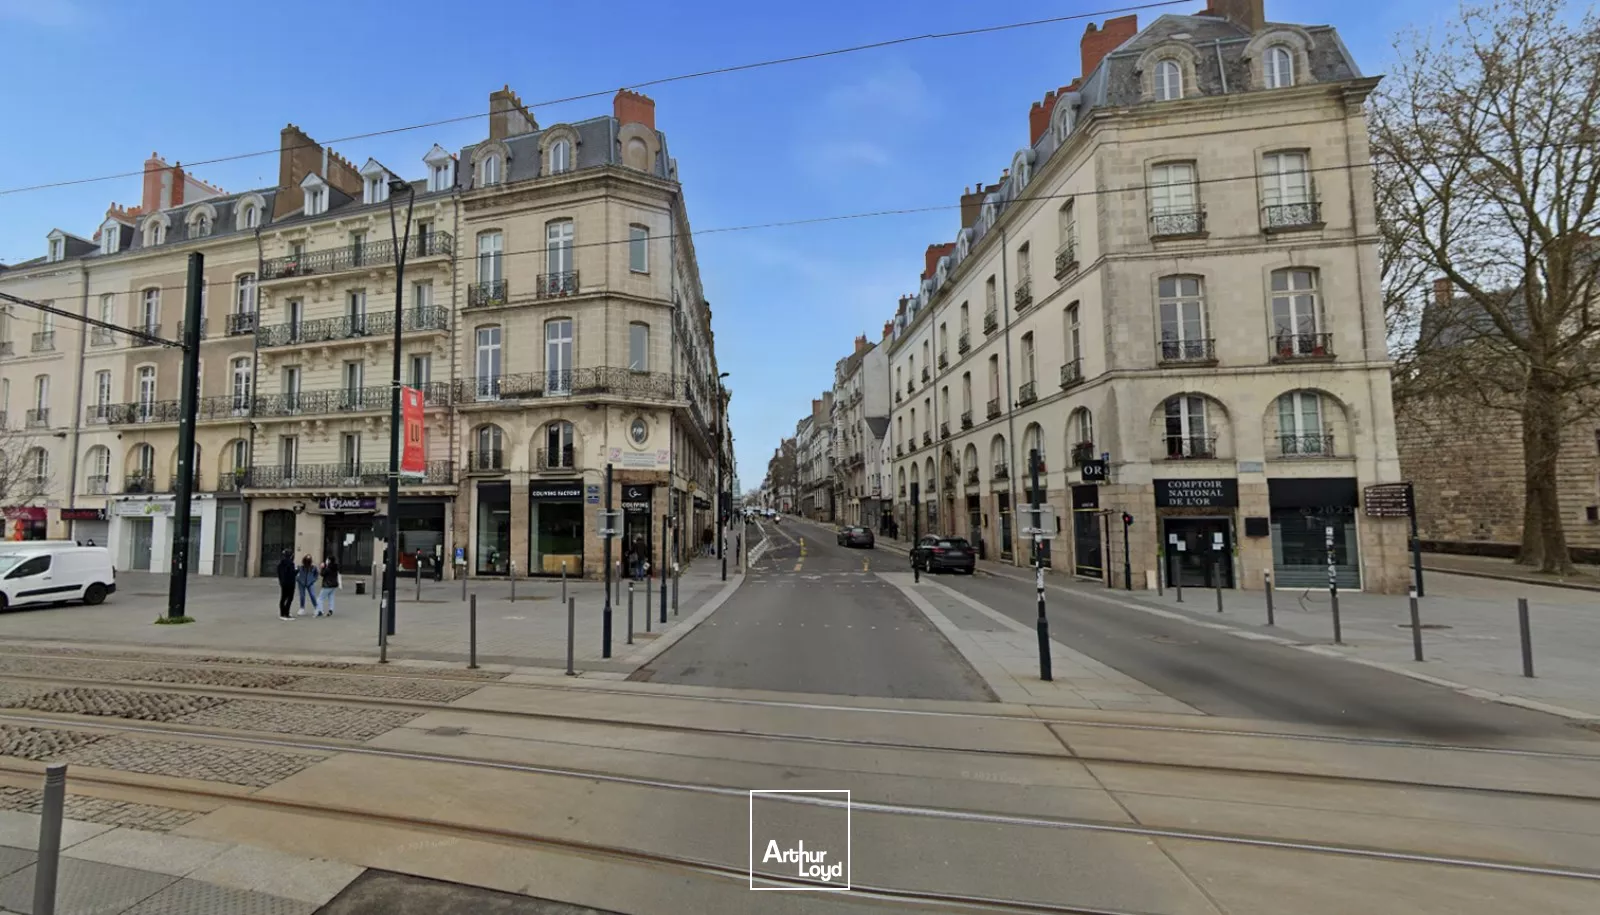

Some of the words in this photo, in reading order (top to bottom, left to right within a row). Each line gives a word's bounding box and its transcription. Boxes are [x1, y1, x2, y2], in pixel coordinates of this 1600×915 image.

[1083, 465, 1102, 475] OR
[1167, 480, 1223, 489] COMPTOIR
[1168, 489, 1224, 497] NATIONAL
[1168, 497, 1184, 505] DE
[1186, 497, 1211, 505] L'OR
